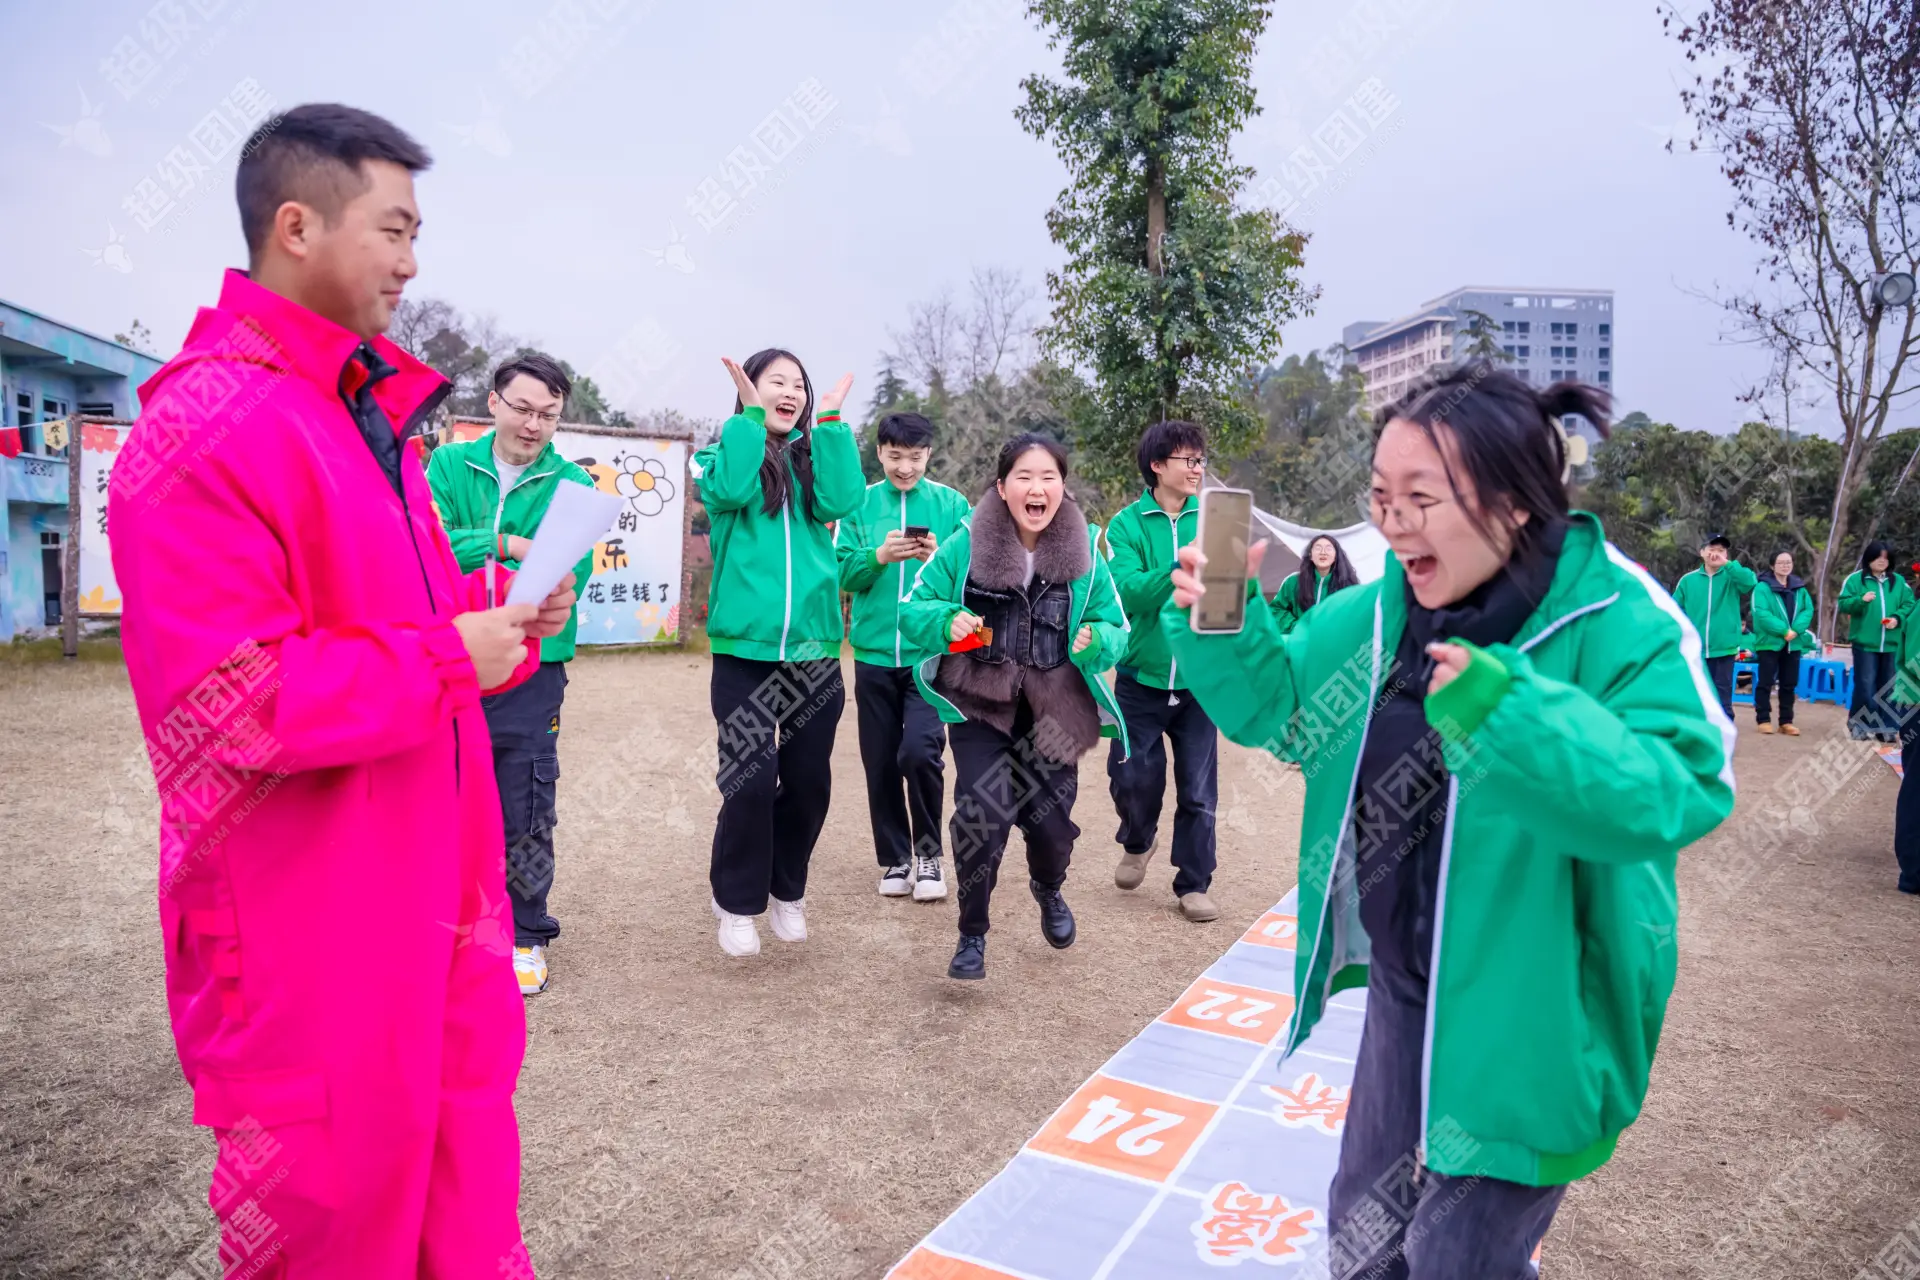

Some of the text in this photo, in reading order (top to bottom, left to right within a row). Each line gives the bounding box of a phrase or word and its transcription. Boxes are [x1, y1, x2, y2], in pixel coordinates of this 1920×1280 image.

[602, 538, 628, 571] 乐
[587, 582, 670, 604] 花些钱了
[1187, 990, 1276, 1029] 22
[1066, 1094, 1186, 1156] 24
